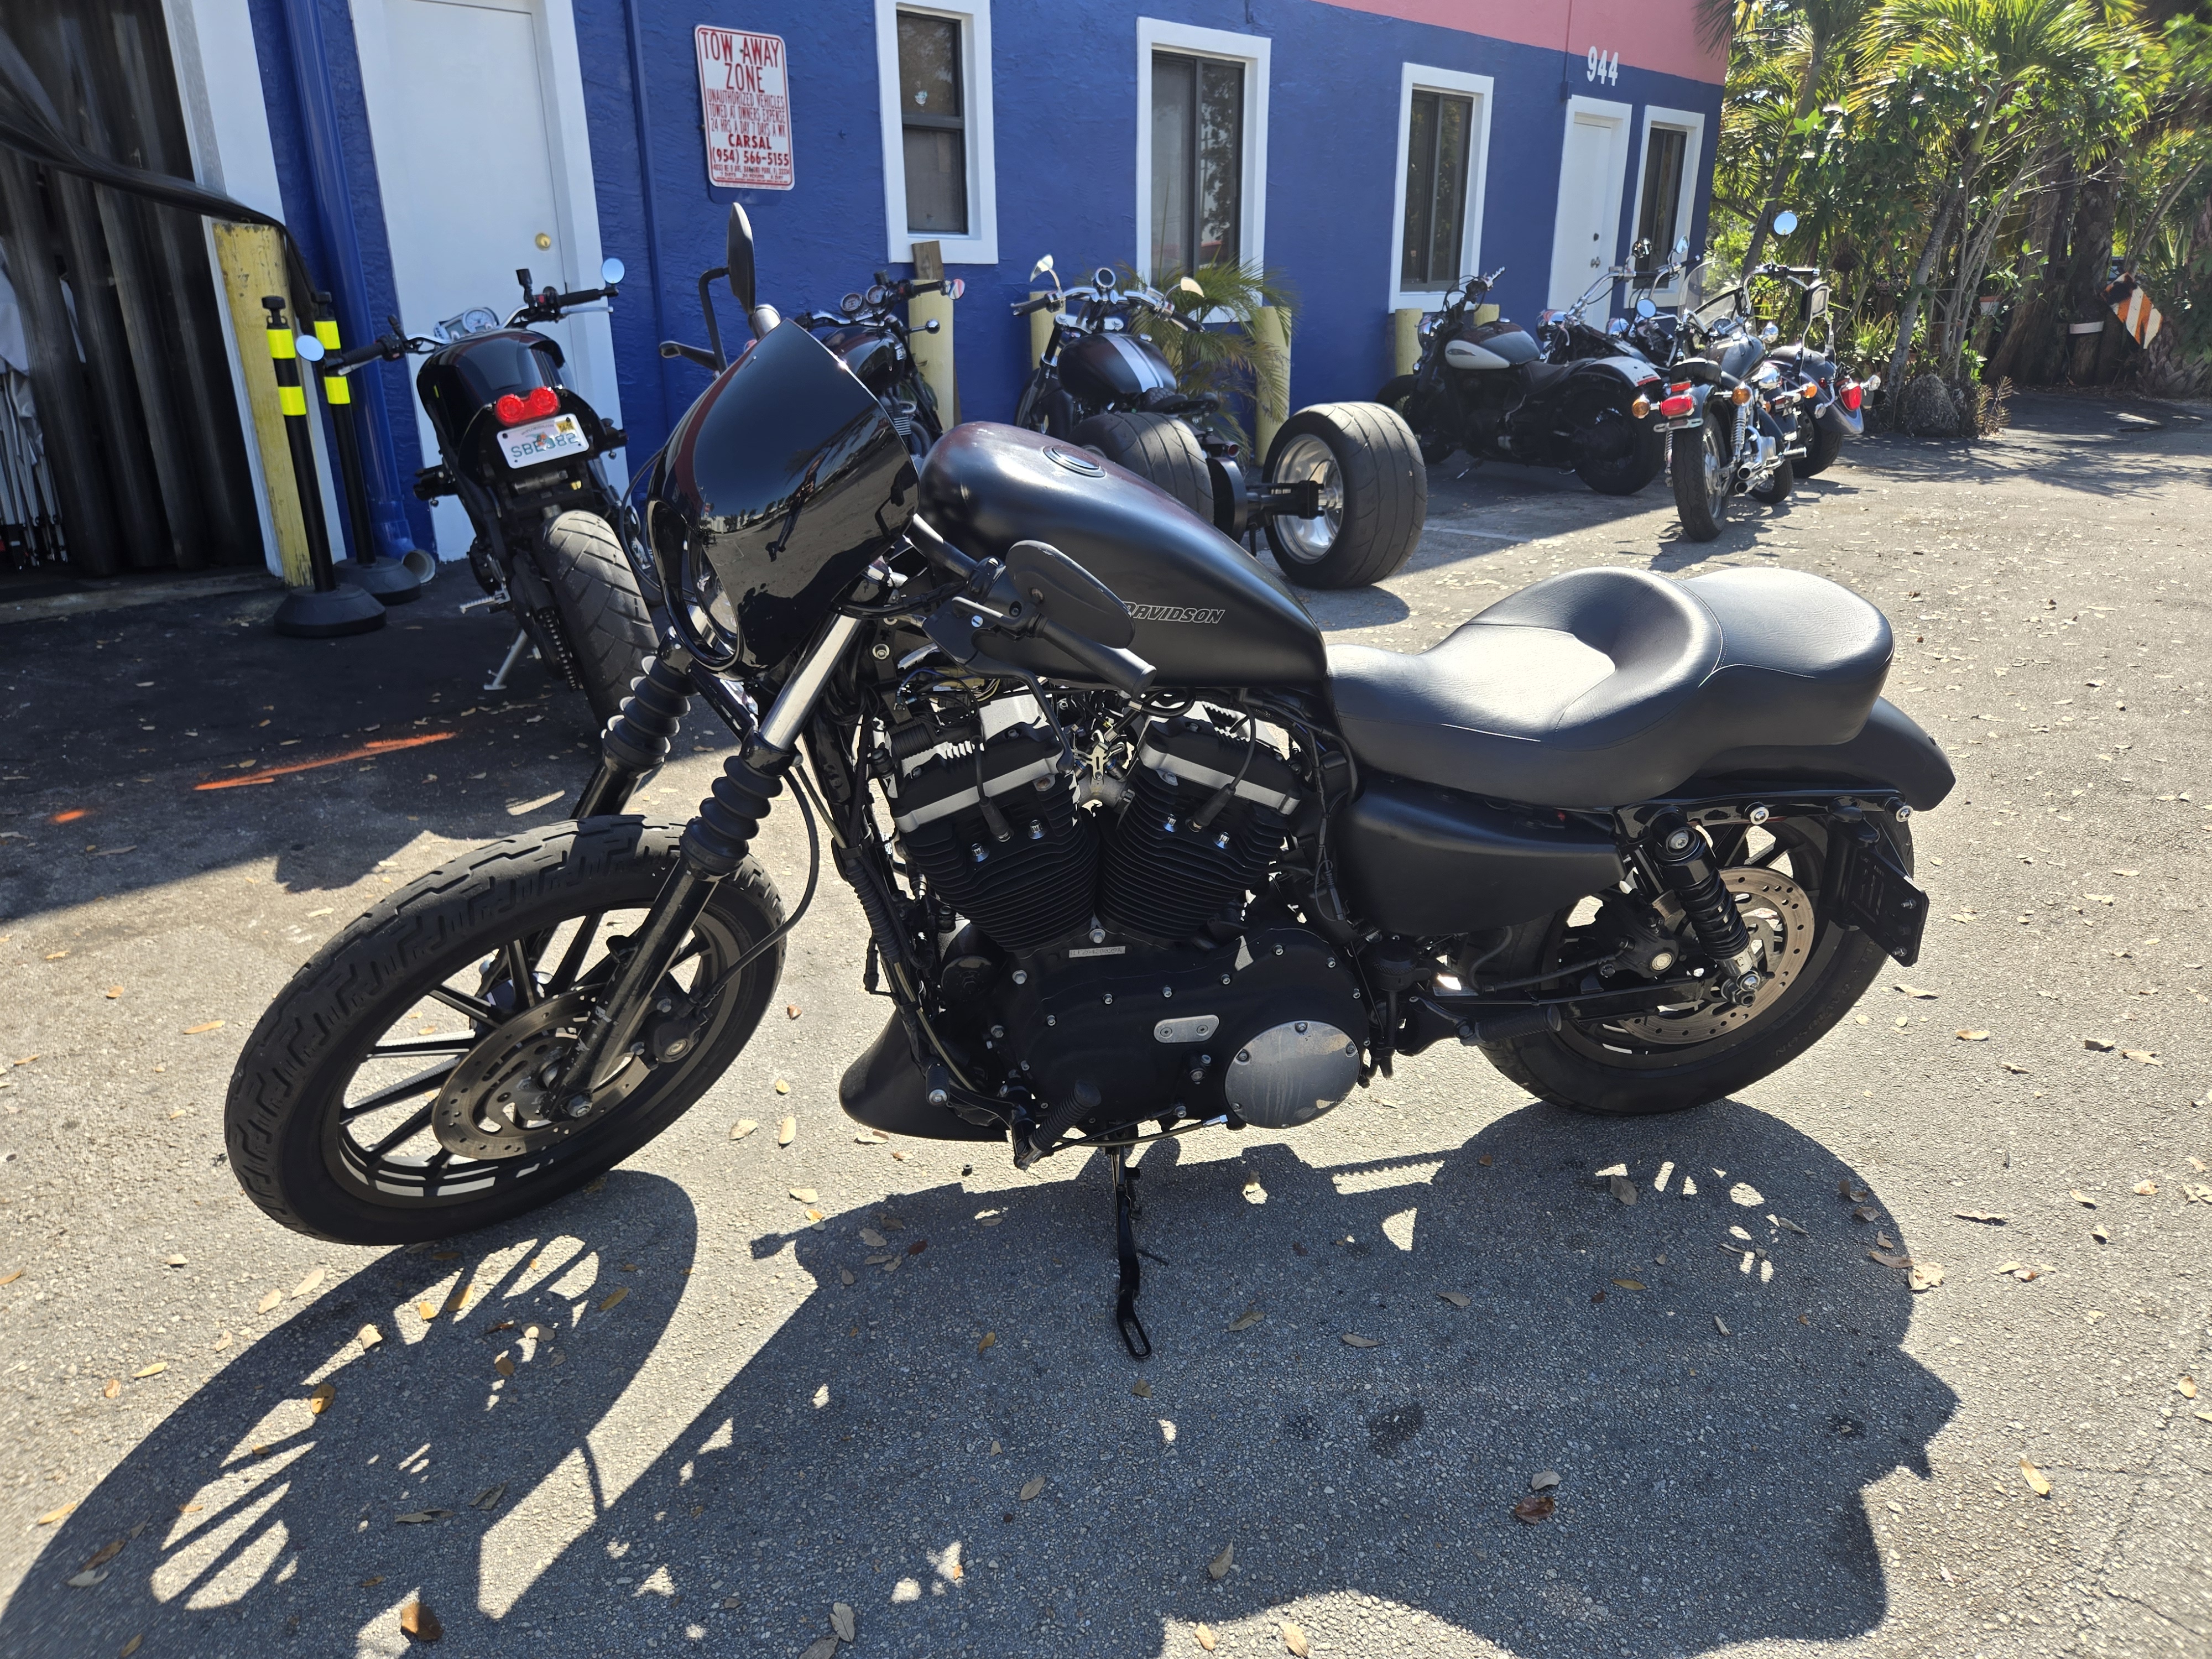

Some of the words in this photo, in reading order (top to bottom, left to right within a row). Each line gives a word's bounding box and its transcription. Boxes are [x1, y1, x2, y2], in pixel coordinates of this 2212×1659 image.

[701, 31, 733, 62] TOW
[743, 37, 779, 68] AWAY
[1587, 46, 1619, 86] 944
[724, 62, 765, 93] ZONE
[707, 88, 754, 107] UNAUTHORIZED
[757, 93, 785, 110] VEHICLES
[708, 103, 728, 119] TOWED
[763, 108, 786, 124] EXPENSE
[728, 133, 772, 150] CARSAL
[712, 147, 739, 164] (954)
[744, 150, 790, 166] 566-5155
